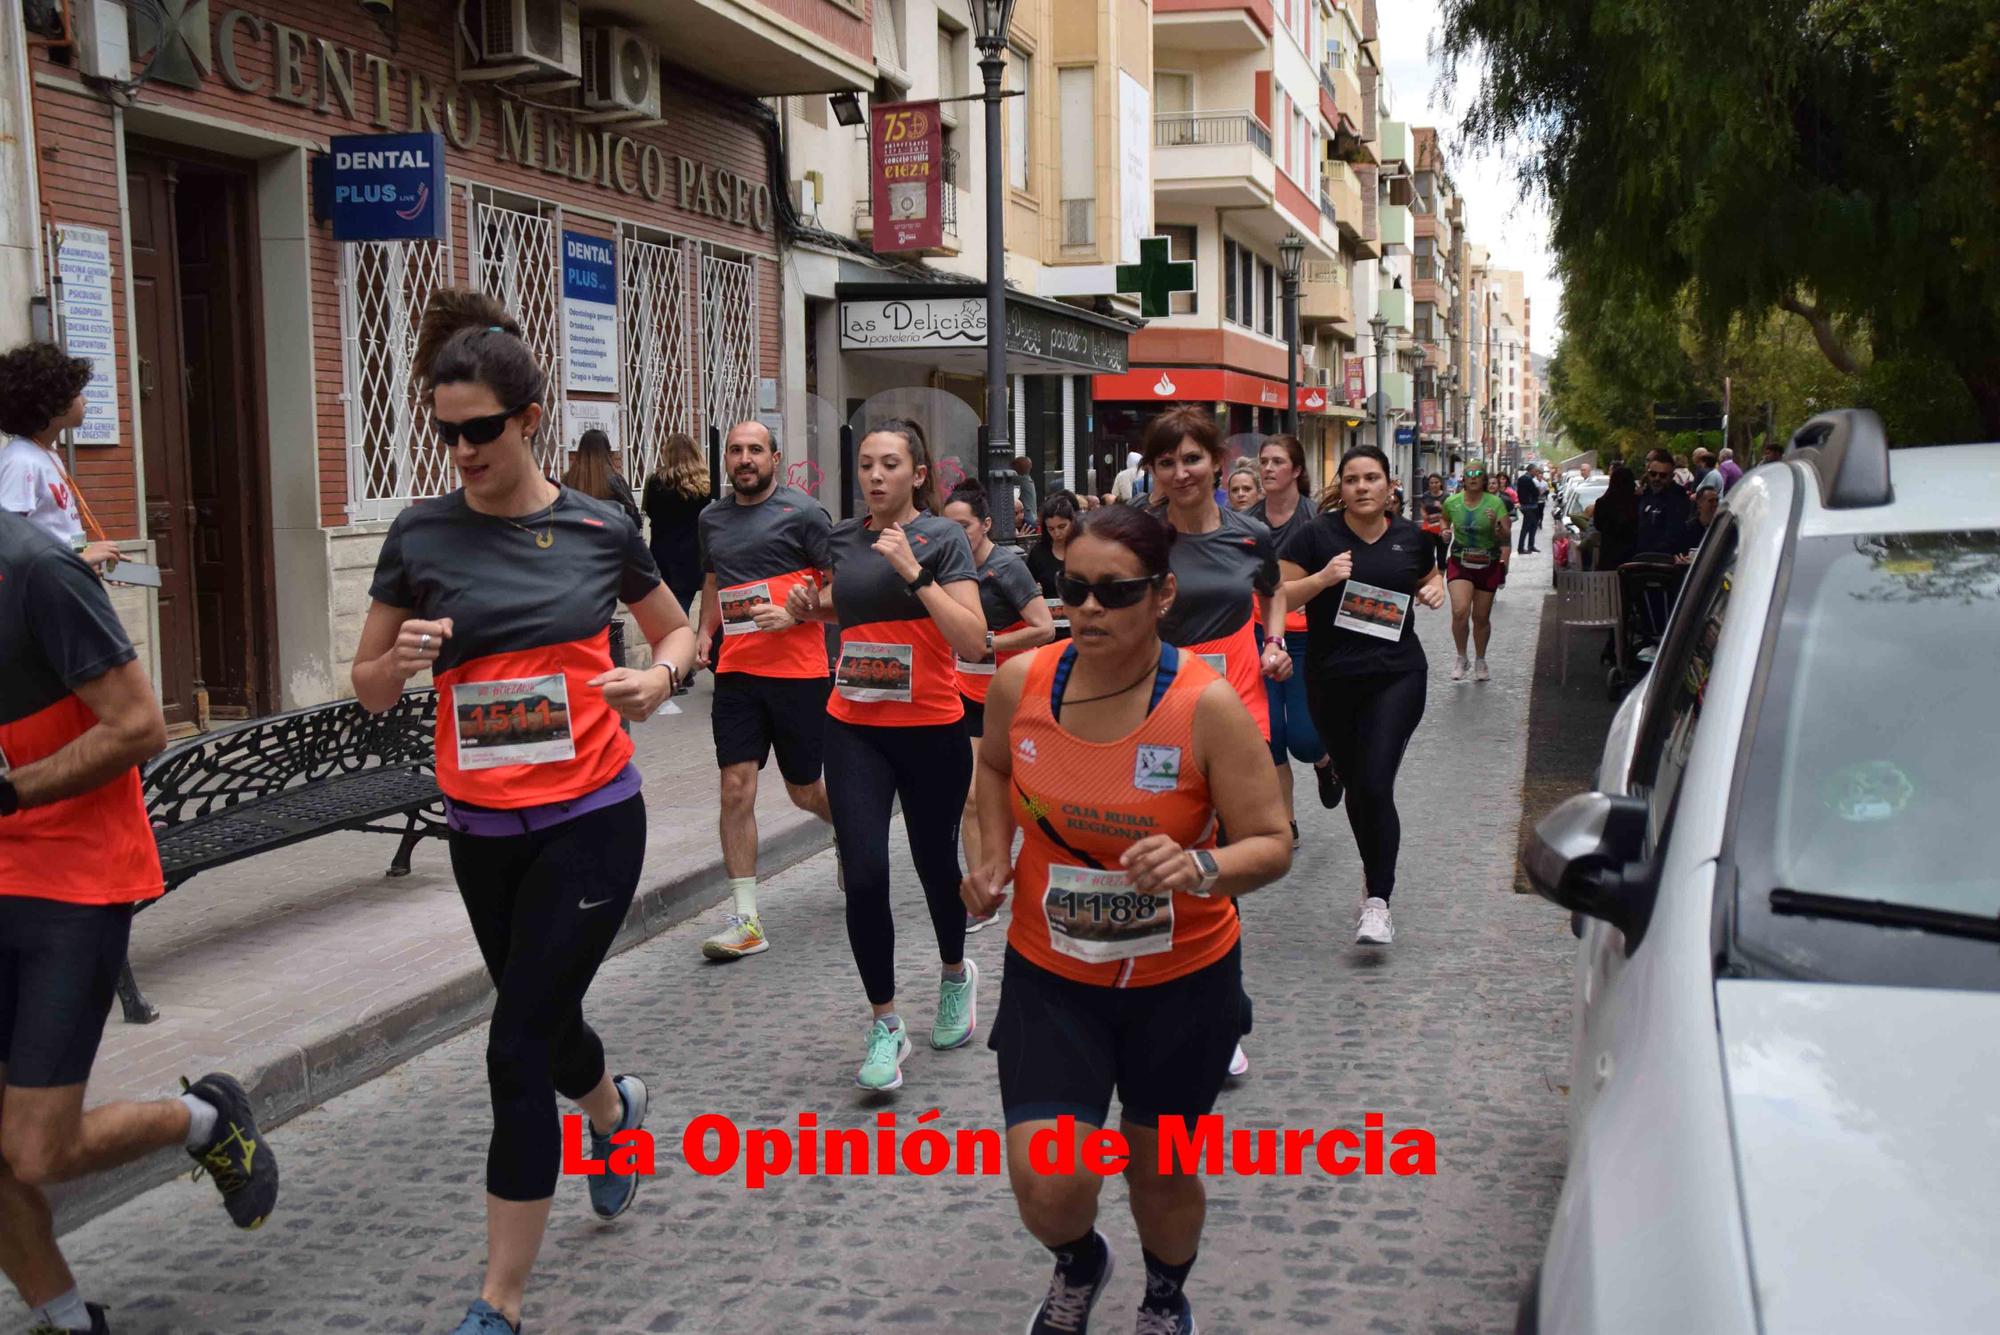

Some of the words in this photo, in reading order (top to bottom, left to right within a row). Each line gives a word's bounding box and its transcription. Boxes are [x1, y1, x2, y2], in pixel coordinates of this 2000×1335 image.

[215, 8, 481, 150] CENTRO
[497, 99, 666, 201] MEDICO
[674, 155, 773, 233] PASEO
[336, 150, 430, 170] DENTAL
[335, 184, 397, 203] PLUS
[567, 240, 613, 266] DENTAL
[568, 268, 599, 288] PLUS
[842, 305, 877, 343] Las
[882, 301, 987, 331] Delicias
[848, 658, 903, 681] 1596
[470, 699, 551, 733] 1511
[1059, 891, 1158, 925] 1188
